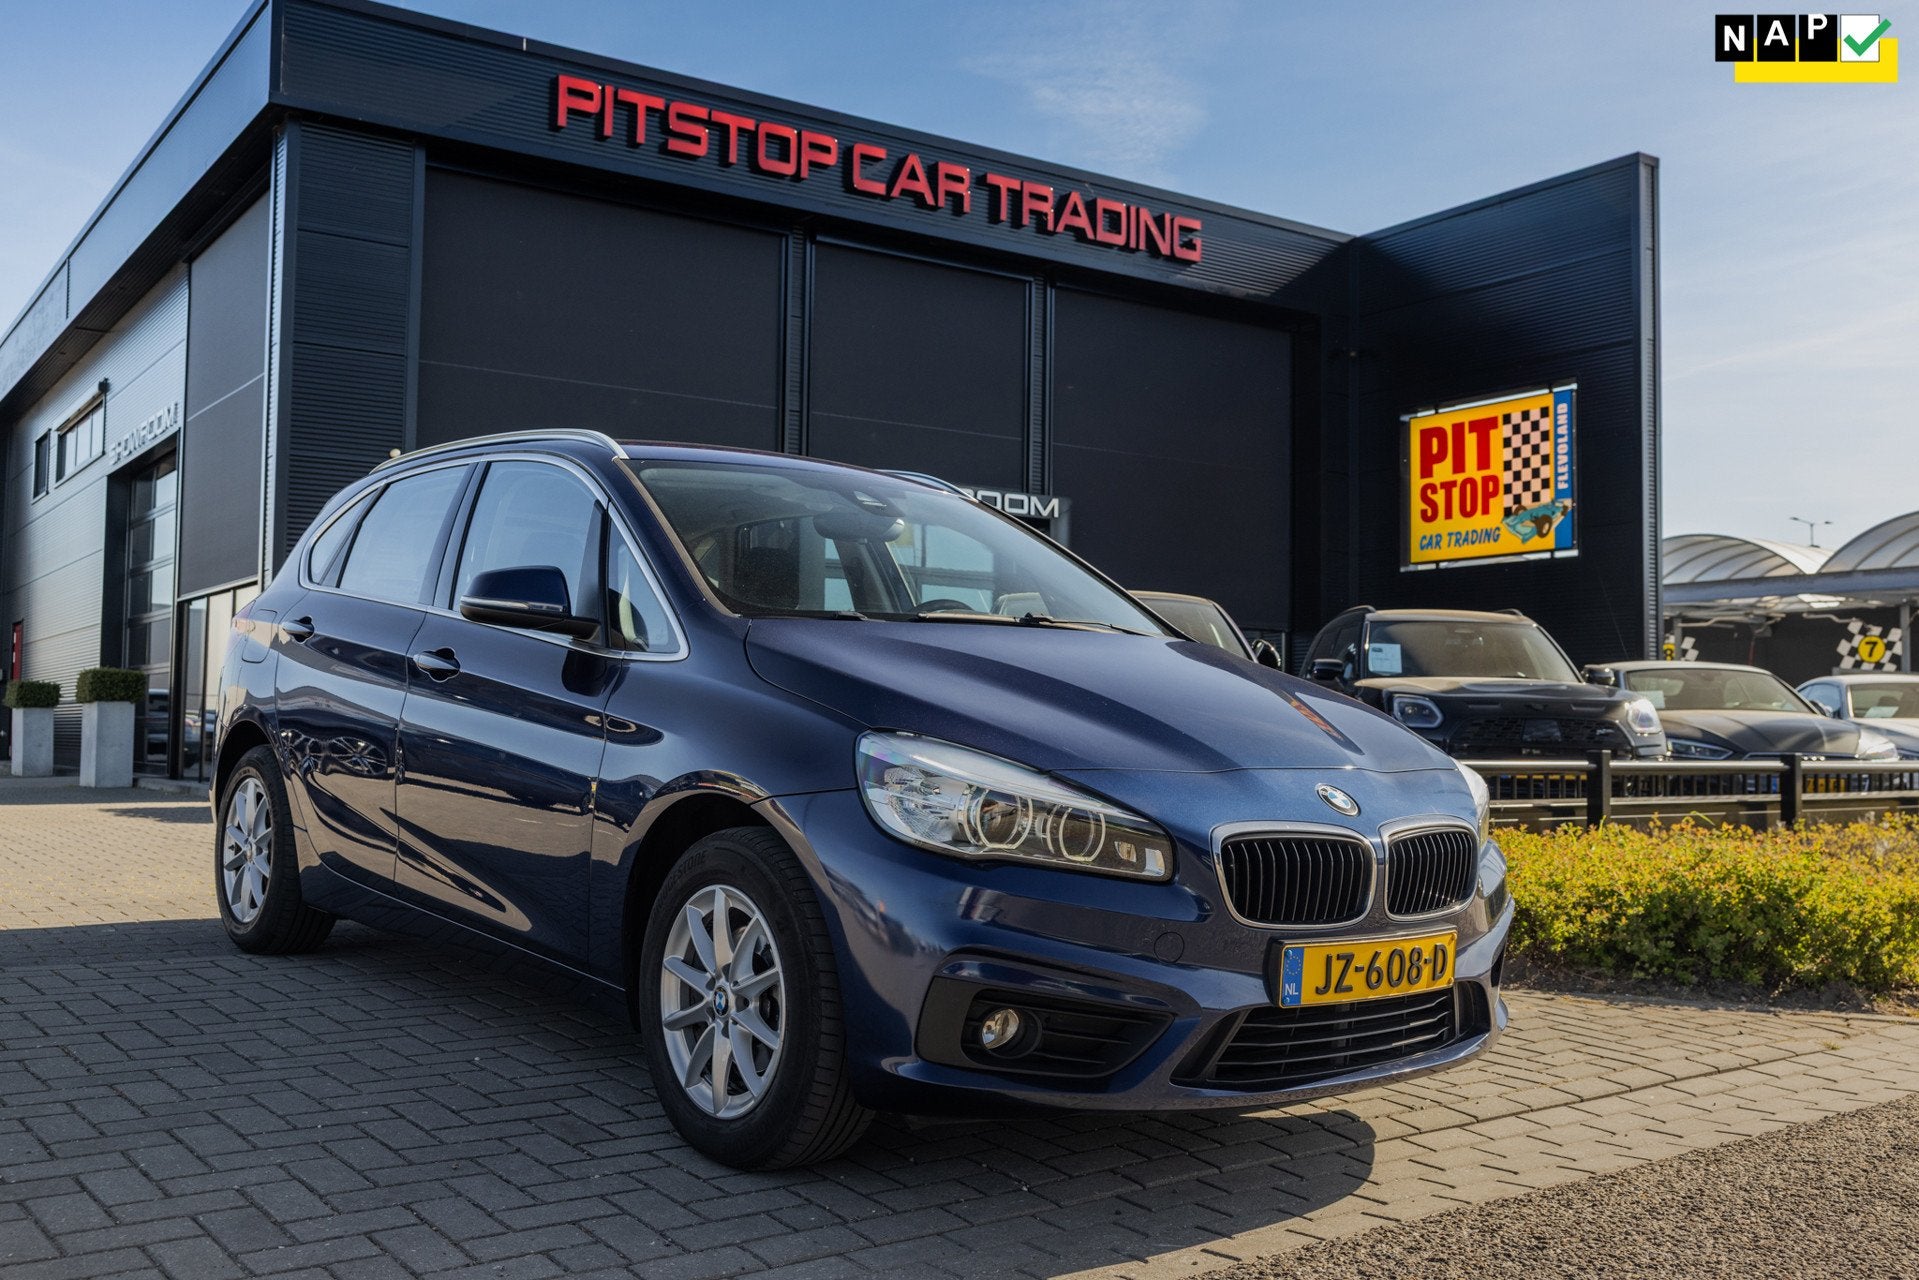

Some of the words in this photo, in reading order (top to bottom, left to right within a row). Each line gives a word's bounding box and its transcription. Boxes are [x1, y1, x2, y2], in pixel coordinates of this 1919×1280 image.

[557, 74, 838, 179] PITSTOP
[853, 142, 971, 214] CAR
[986, 172, 1201, 264] TRADING
[1420, 416, 1498, 479] PIT
[1557, 402, 1568, 490] FLEVOLAND
[1420, 475, 1500, 523] STOP
[1420, 533, 1442, 551] CAR
[1447, 526, 1501, 548] TRADING
[1865, 641, 1878, 658] 7
[1284, 983, 1299, 996] NL
[1316, 944, 1449, 995] JZ-608-D
